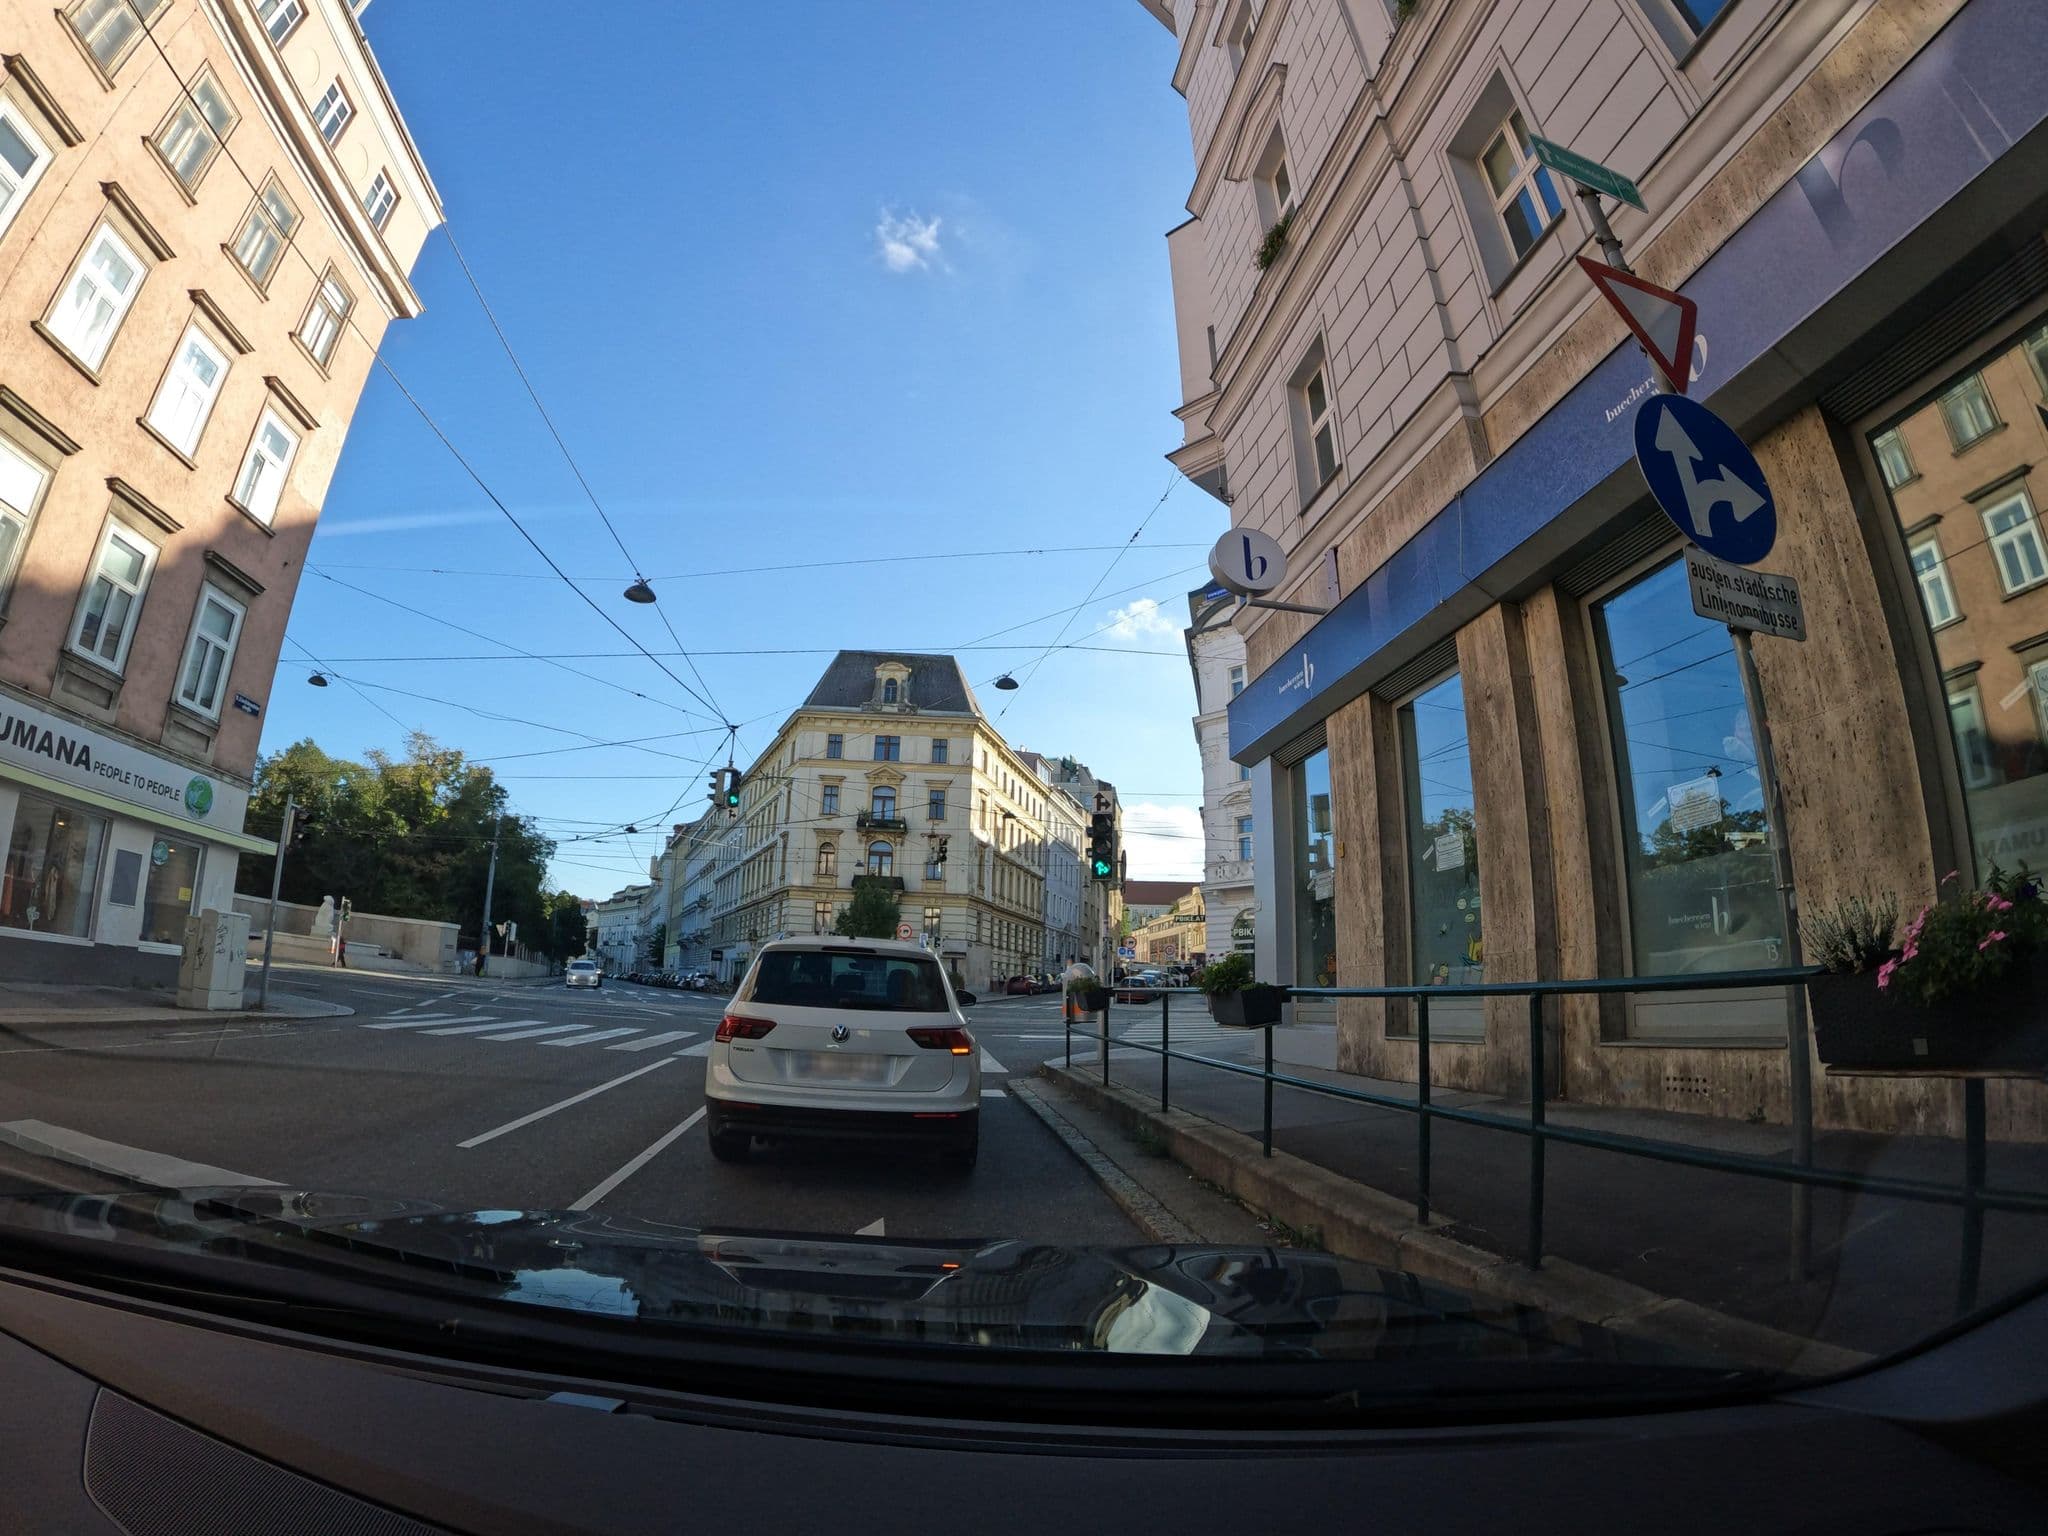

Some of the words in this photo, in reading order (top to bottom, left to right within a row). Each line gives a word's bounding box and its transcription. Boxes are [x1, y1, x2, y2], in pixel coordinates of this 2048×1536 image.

[1242, 533, 1268, 581] b
[93, 761, 131, 785] PEOPLE
[133, 774, 145, 789] TO
[146, 780, 181, 801] PEOPLE
[1233, 927, 1255, 937] PBIK
